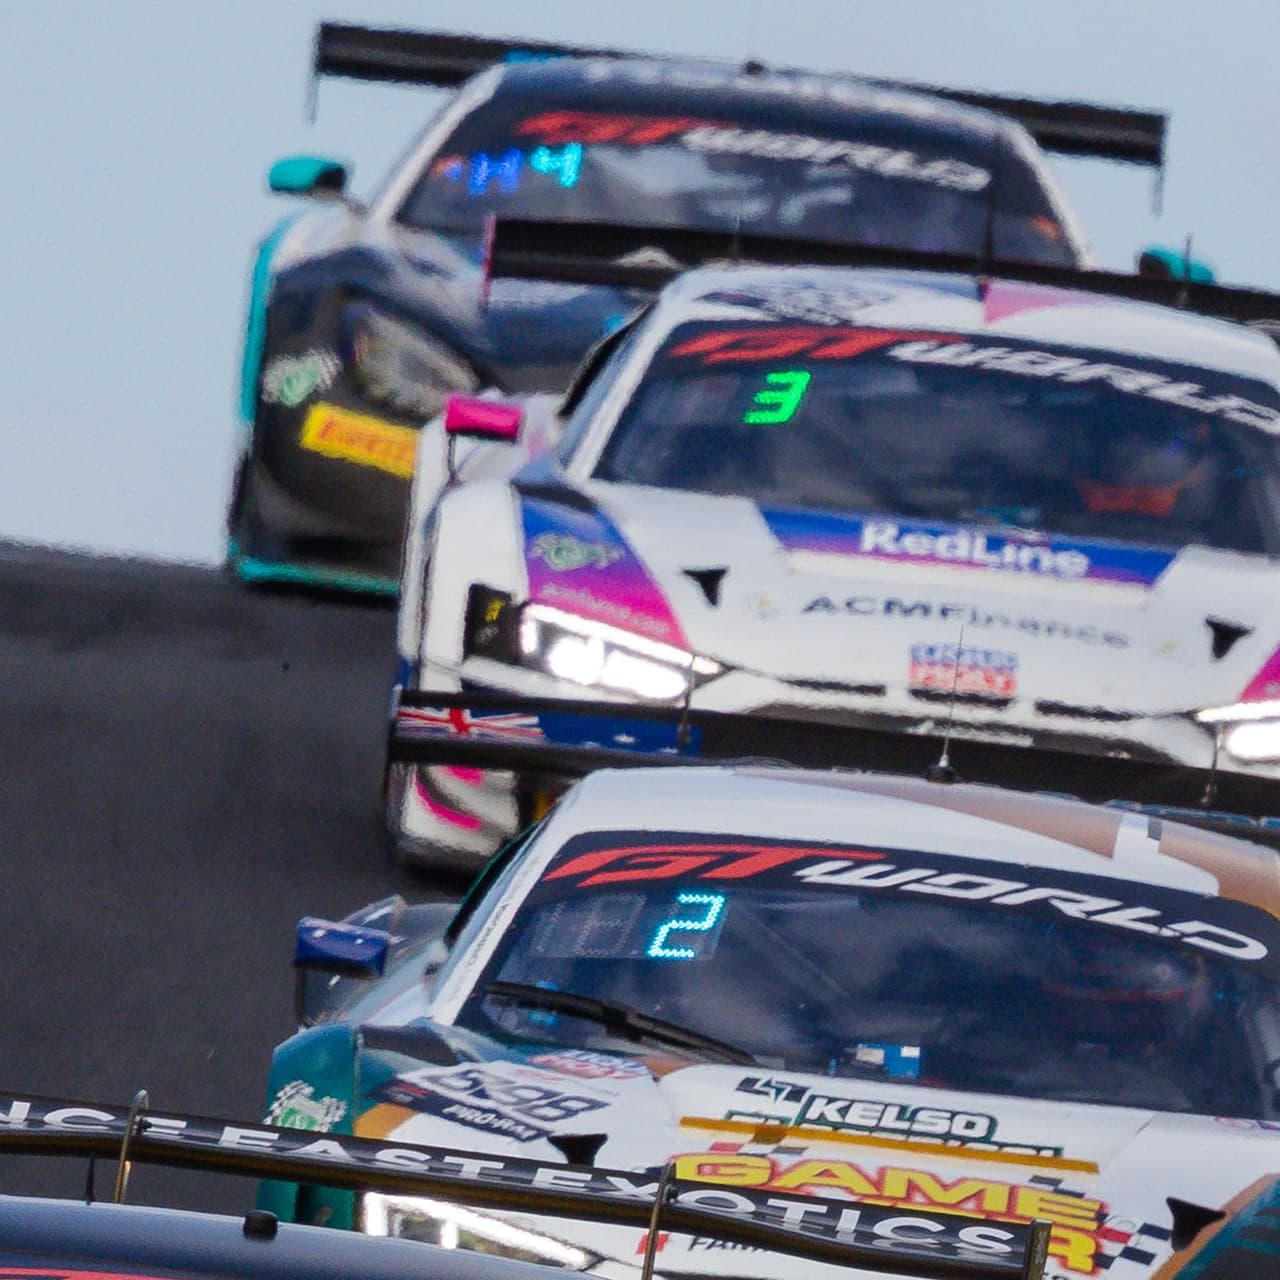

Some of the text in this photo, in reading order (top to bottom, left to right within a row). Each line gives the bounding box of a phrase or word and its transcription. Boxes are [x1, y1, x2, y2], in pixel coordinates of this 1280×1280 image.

[670, 325, 963, 364] GT
[743, 370, 811, 424] 3
[860, 522, 1090, 578] RedLine
[542, 843, 1268, 960] GT WORLD
[646, 893, 725, 959] 2
[805, 1095, 995, 1140] KELSO
[219, 1125, 504, 1180] EAST
[531, 1167, 1015, 1254] EXOTICS
[675, 1154, 1103, 1230] GAME
